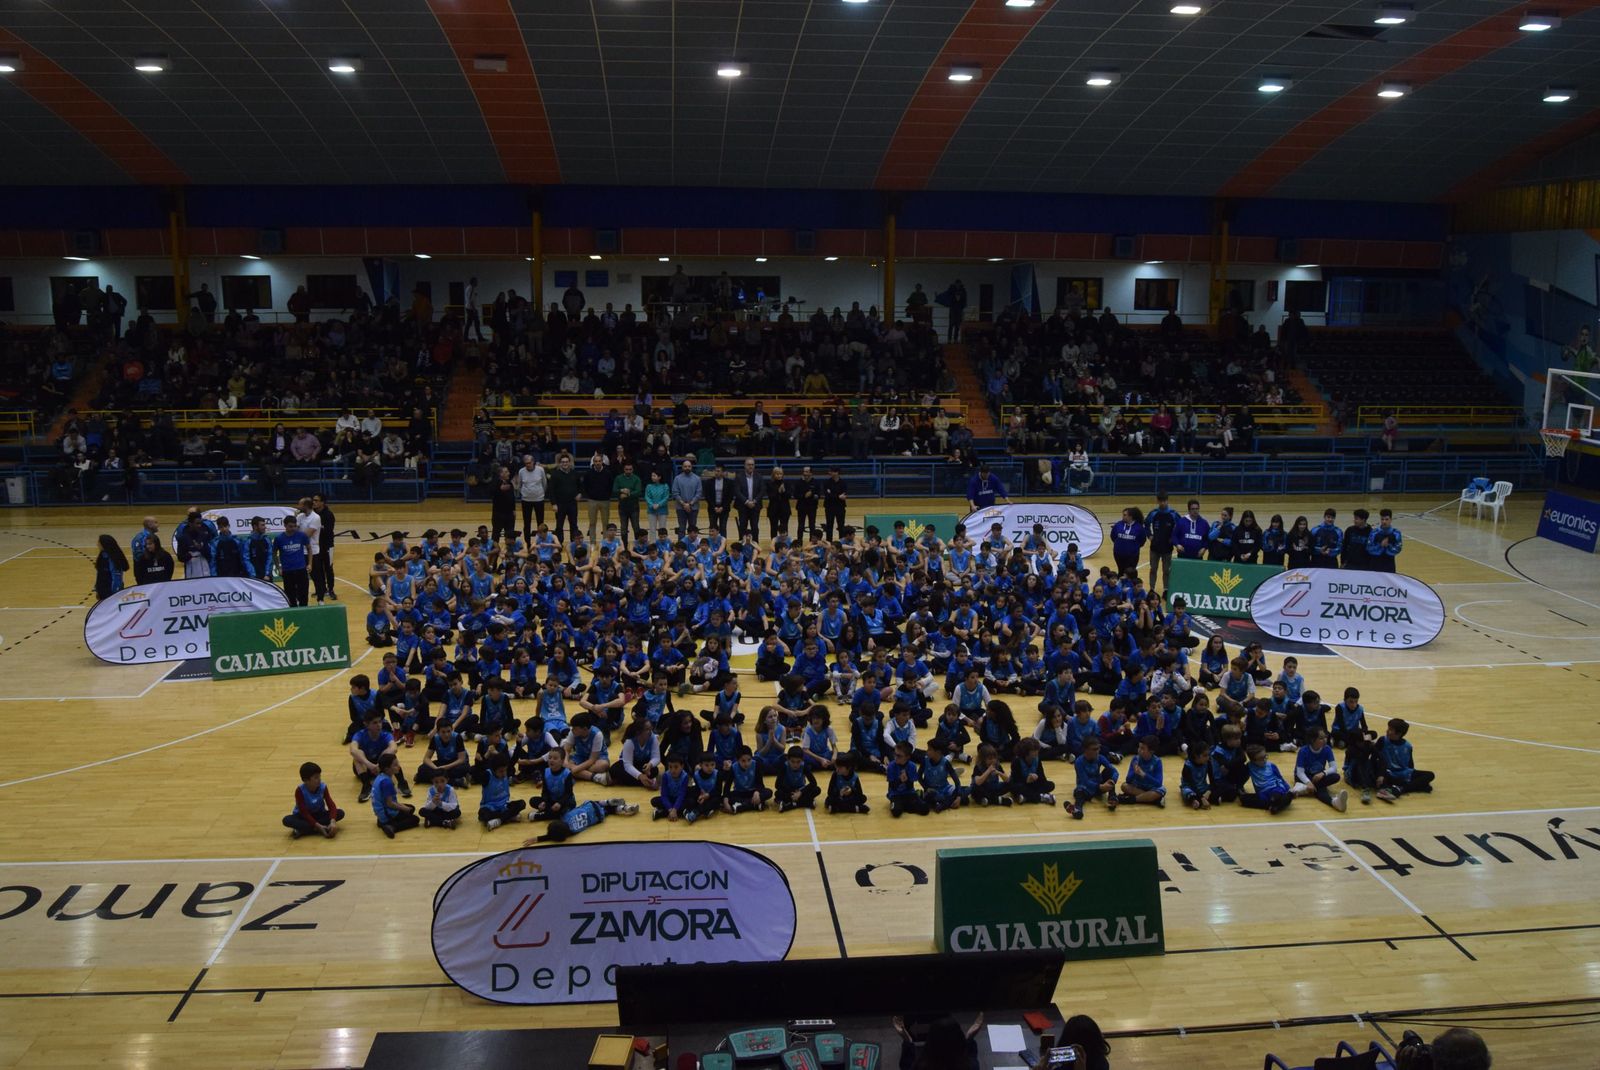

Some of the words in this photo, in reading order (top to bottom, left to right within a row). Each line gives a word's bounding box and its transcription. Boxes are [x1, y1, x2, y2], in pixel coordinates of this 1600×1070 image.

[1550, 510, 1598, 534] euronics
[163, 614, 210, 635] ZAM
[1320, 602, 1413, 624] ZAMORA
[1279, 622, 1413, 645] Deportes
[215, 652, 270, 673] CAJA
[271, 645, 348, 669] RURAL
[570, 908, 741, 945] ZAMORA
[950, 922, 1037, 953] CAJA
[1038, 915, 1159, 951] RURAL
